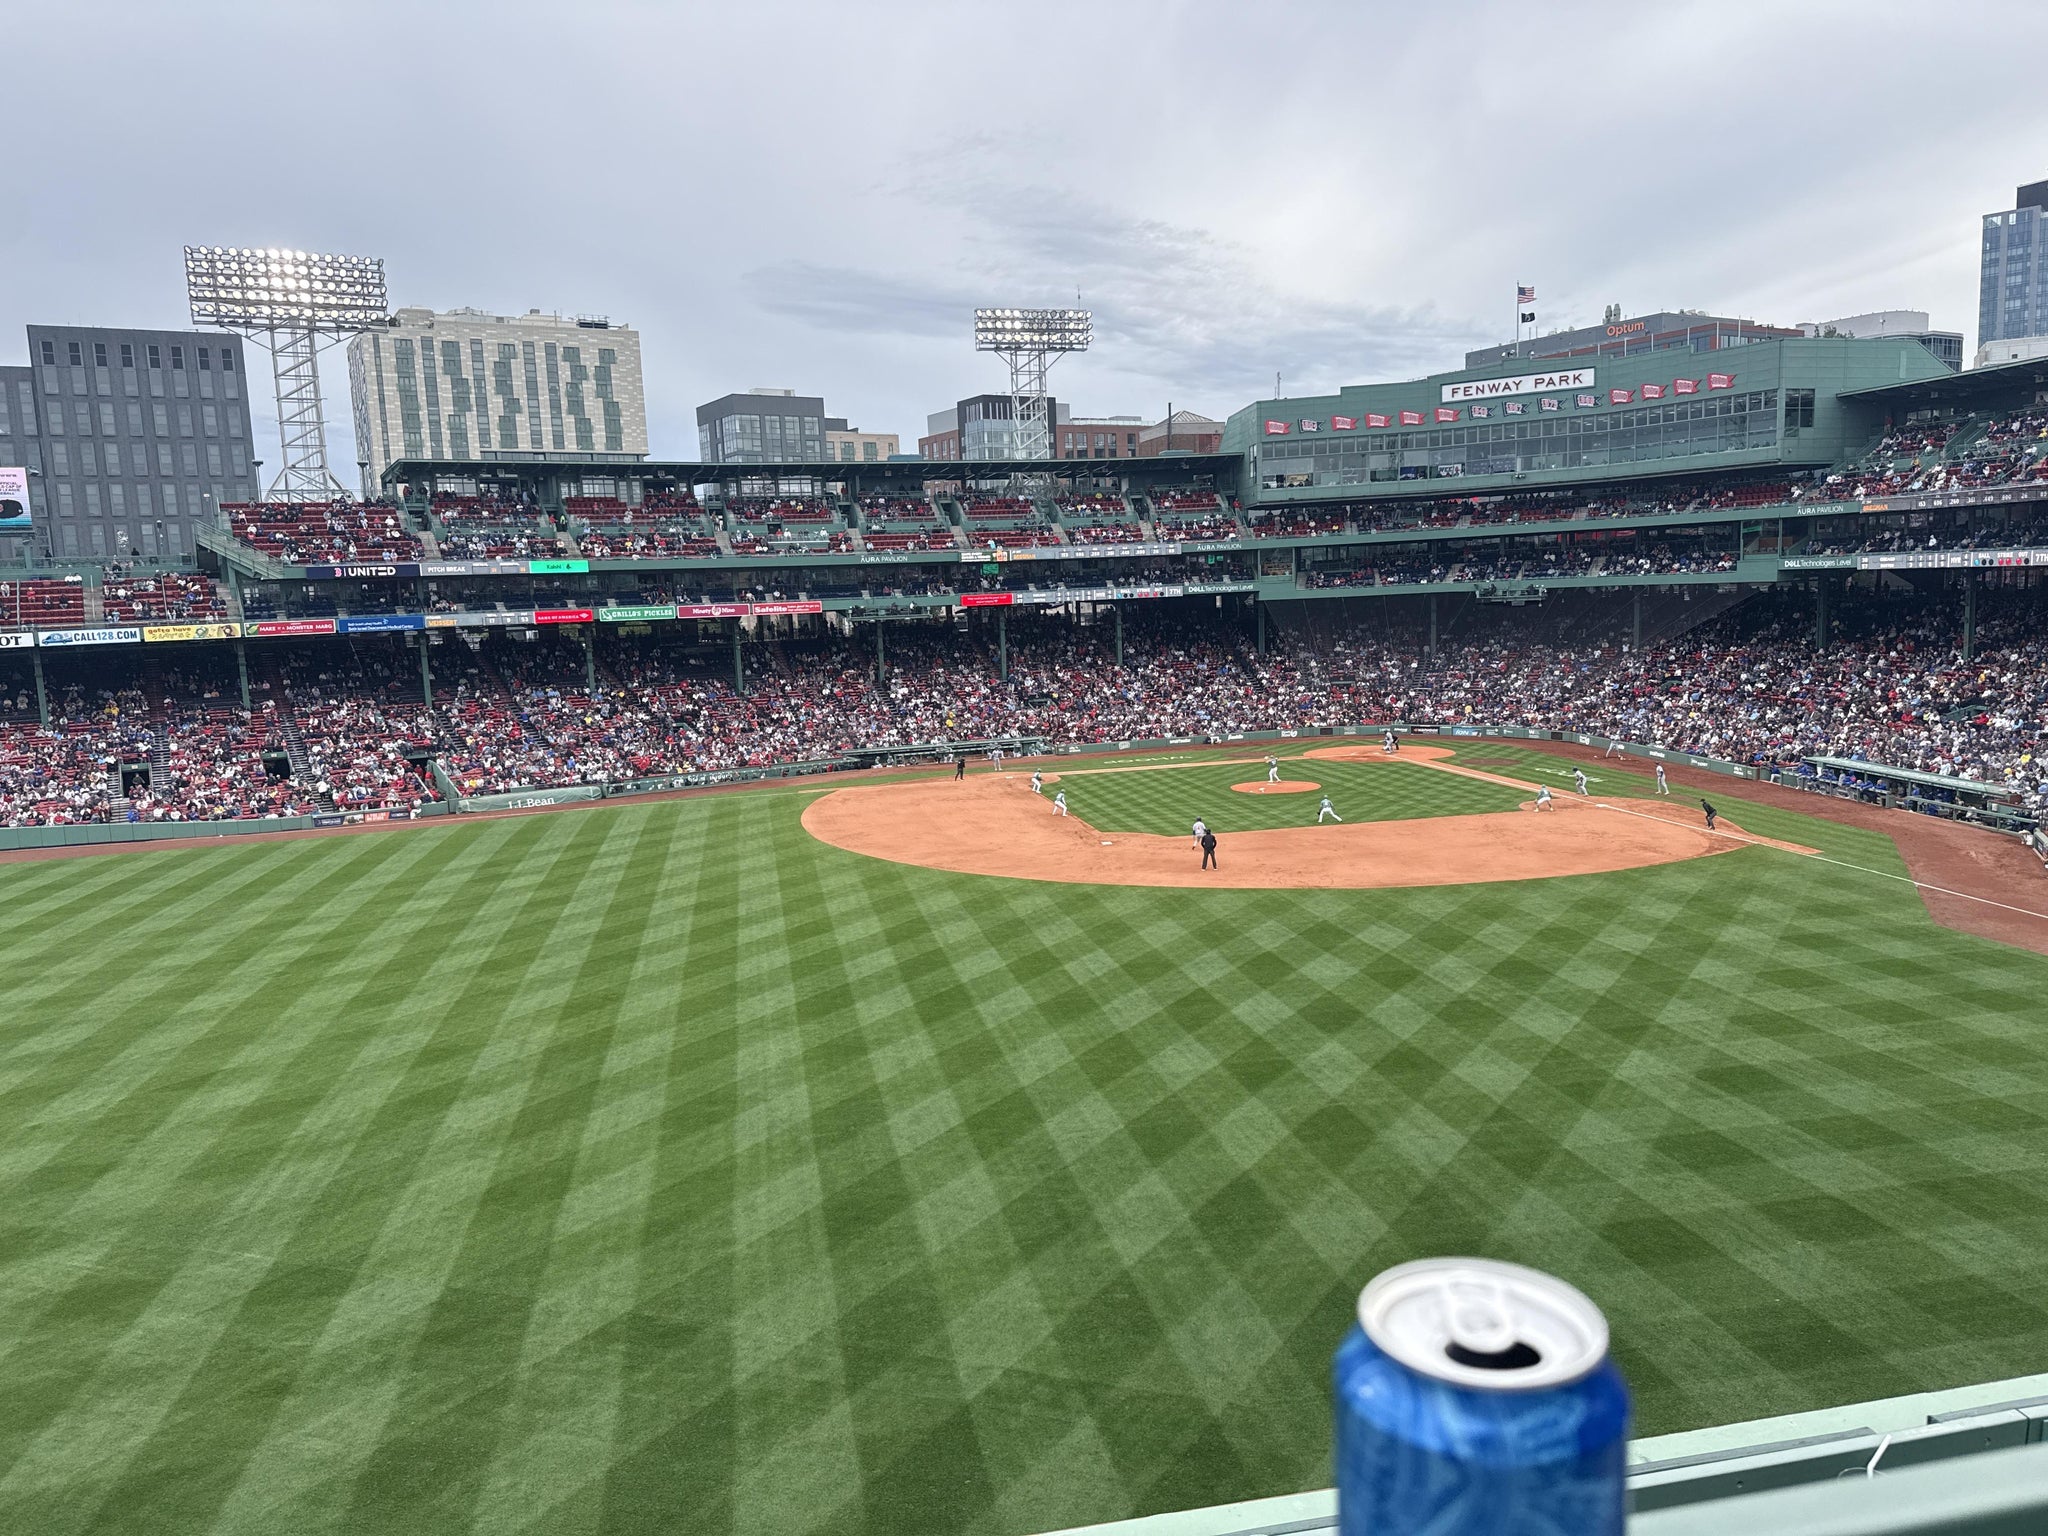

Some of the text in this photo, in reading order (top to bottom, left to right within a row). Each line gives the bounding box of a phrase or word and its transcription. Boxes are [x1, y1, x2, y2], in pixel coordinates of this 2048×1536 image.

[1606, 321, 1645, 337] Optum
[1451, 373, 1583, 398] FENWAY PARK
[1816, 505, 1844, 513] PAVILION
[2035, 553, 2048, 562] 7TH
[1800, 560, 1836, 568] Technologies
[347, 566, 396, 576] UNITED
[1204, 585, 1238, 593] Technologies
[147, 627, 171, 635] gotta
[73, 630, 138, 642] CALL128.COM
